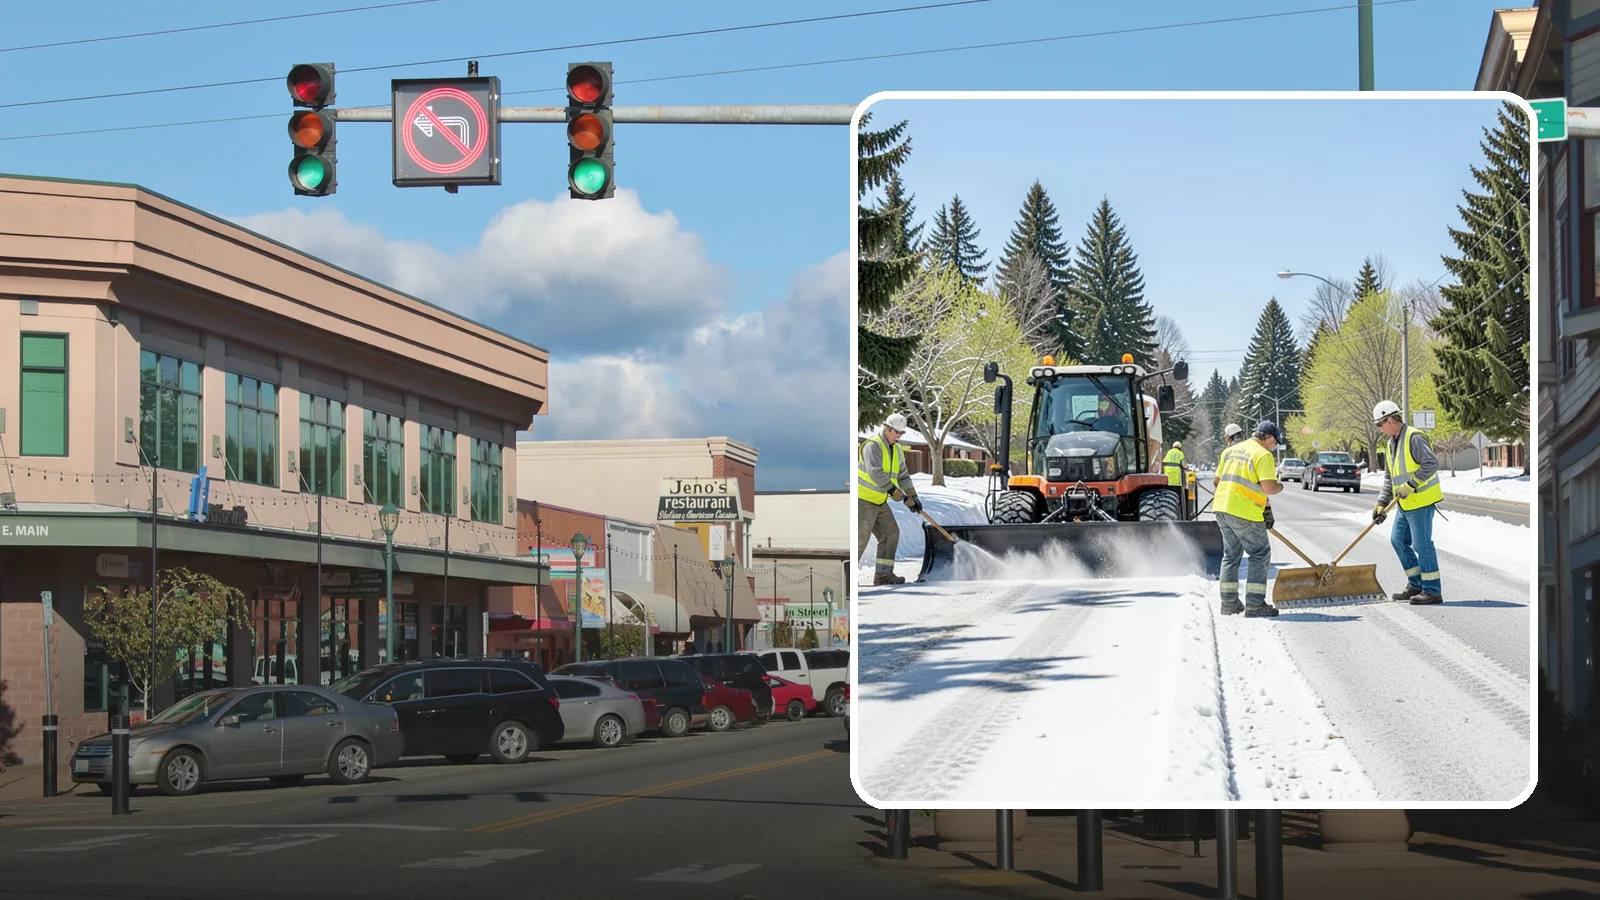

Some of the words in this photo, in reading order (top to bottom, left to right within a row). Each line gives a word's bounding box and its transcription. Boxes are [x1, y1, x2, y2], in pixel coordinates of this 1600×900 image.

[669, 480, 727, 494] Jeno's
[665, 496, 731, 509] restaurant
[658, 510, 681, 519] Italian
[685, 510, 714, 519] American
[715, 510, 737, 519] Cuisine
[2, 525, 13, 536] E.
[15, 525, 49, 536] MAIN
[797, 607, 828, 617] Street
